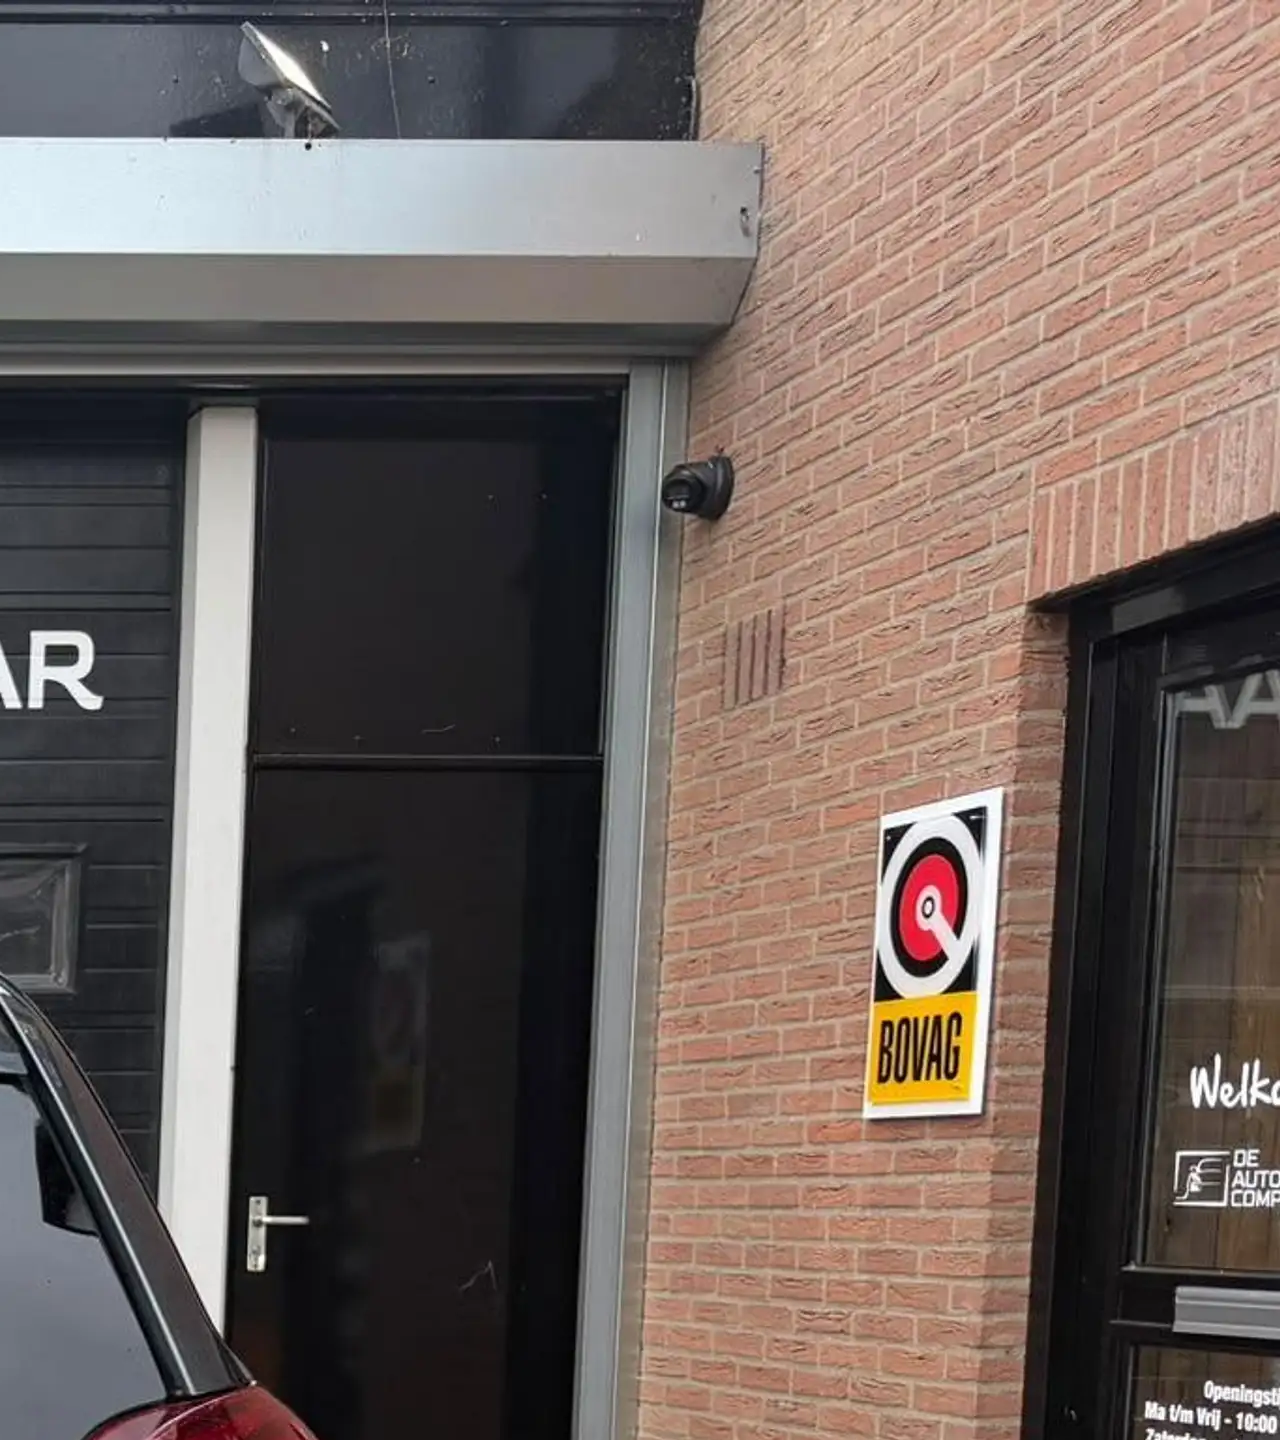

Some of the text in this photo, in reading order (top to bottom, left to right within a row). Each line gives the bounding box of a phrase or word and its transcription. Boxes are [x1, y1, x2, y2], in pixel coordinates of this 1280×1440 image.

[878, 1011, 962, 1083] BOVAG
[1233, 1148, 1260, 1167] DE
[1144, 1400, 1166, 1421] Ma
[1169, 1404, 1193, 1424] t/m
[1196, 1406, 1221, 1431] Vrij
[1236, 1411, 1278, 1434] 10:00
